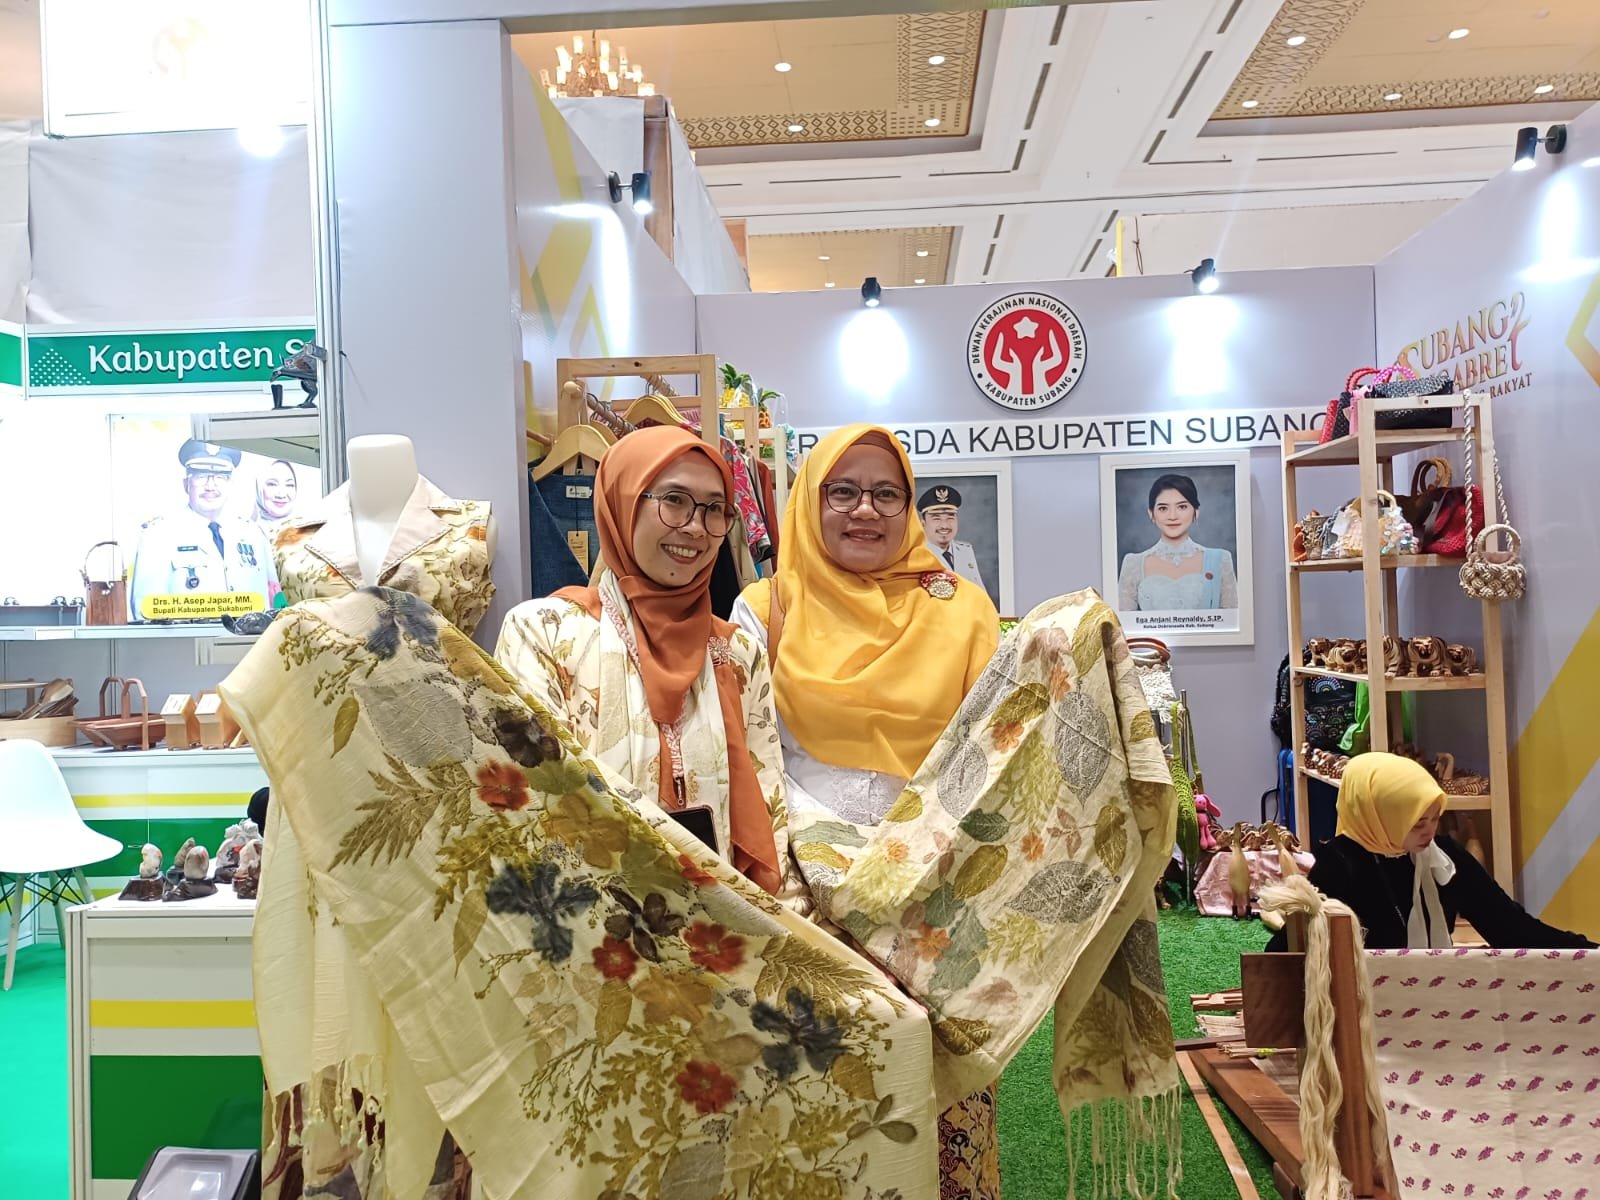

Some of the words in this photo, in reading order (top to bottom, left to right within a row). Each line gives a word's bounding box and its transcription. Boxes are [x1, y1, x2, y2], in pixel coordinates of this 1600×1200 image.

[972, 331, 984, 364] DEWAN
[980, 297, 1025, 330] KERAJINAN
[1028, 297, 1071, 323] NASIONAL
[1067, 323, 1082, 360] DAERAH
[1393, 299, 1510, 380] SUBANG
[88, 340, 274, 380] Kabupaten
[985, 381, 1036, 405] KABUPATEN
[1038, 375, 1072, 403] SUBANG
[1490, 372, 1532, 399] RAKYAT
[969, 419, 1172, 453] KABUPATEN
[153, 597, 170, 606] Drs.
[172, 597, 181, 605] H.
[183, 597, 204, 607] Asep
[207, 596, 233, 605] Japar,
[235, 595, 252, 603] MM.
[177, 606, 216, 614] Kabupaten
